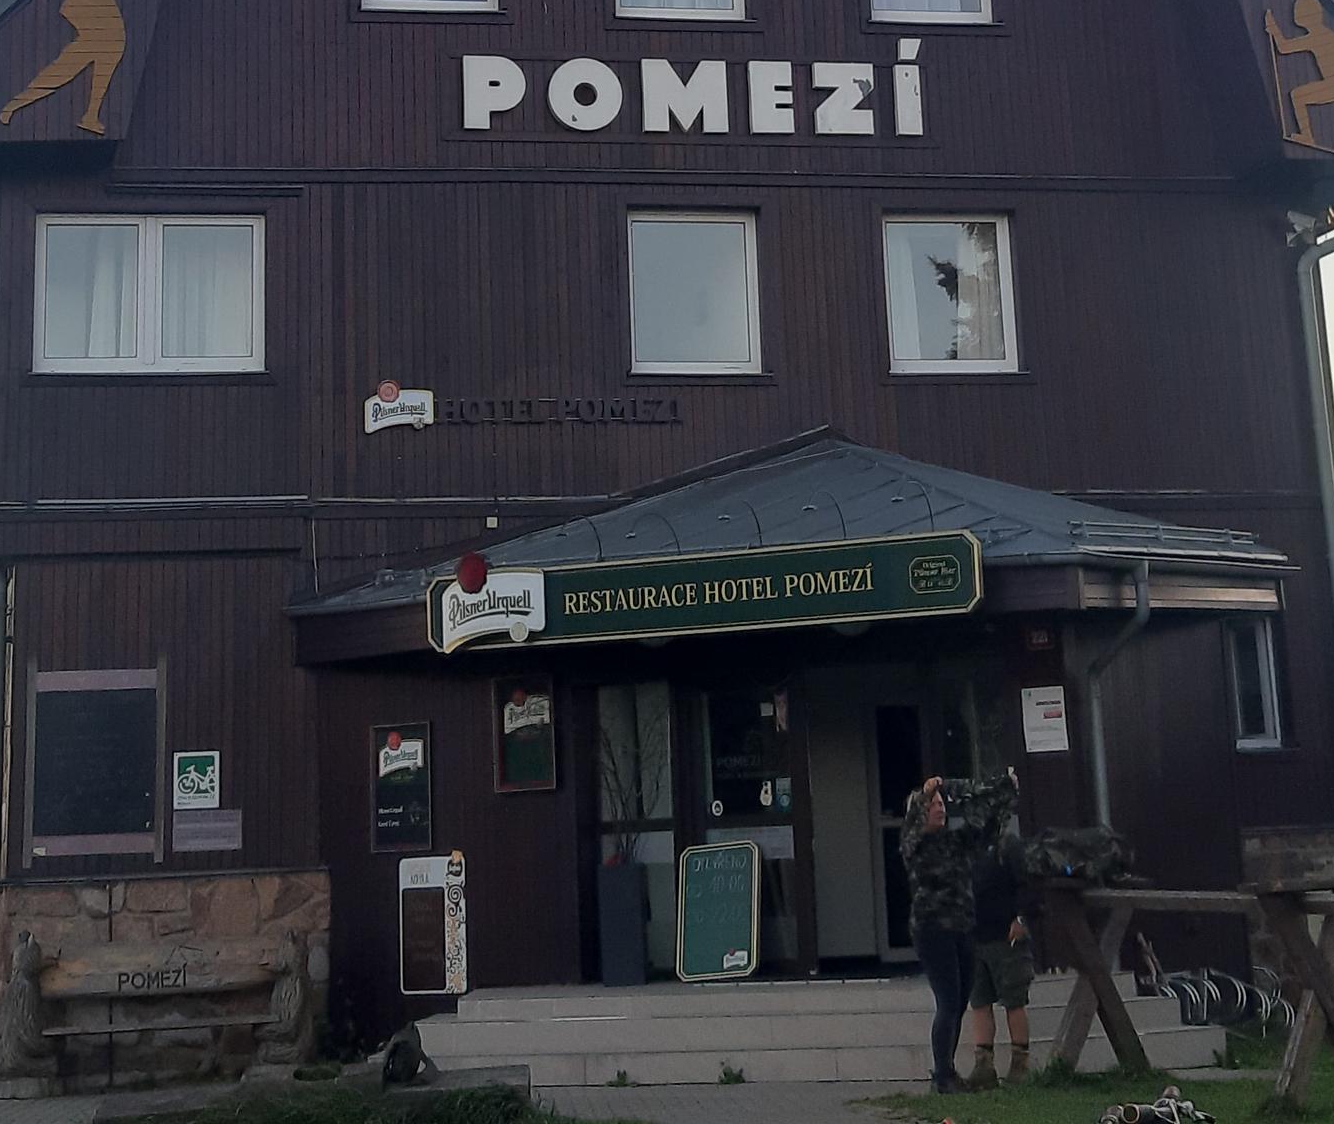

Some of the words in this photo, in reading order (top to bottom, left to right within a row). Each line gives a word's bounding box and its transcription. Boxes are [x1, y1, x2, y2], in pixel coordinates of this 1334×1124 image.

[462, 37, 925, 136] POMEZÍ
[372, 402, 400, 423] Pilsner
[564, 581, 698, 615] RESTAURACE
[703, 575, 778, 605] HOTEL
[784, 562, 875, 598] POMEZÍ
[449, 594, 488, 631] Pilsner
[486, 589, 534, 618] Urquell
[118, 962, 187, 992] POMEZÍ
